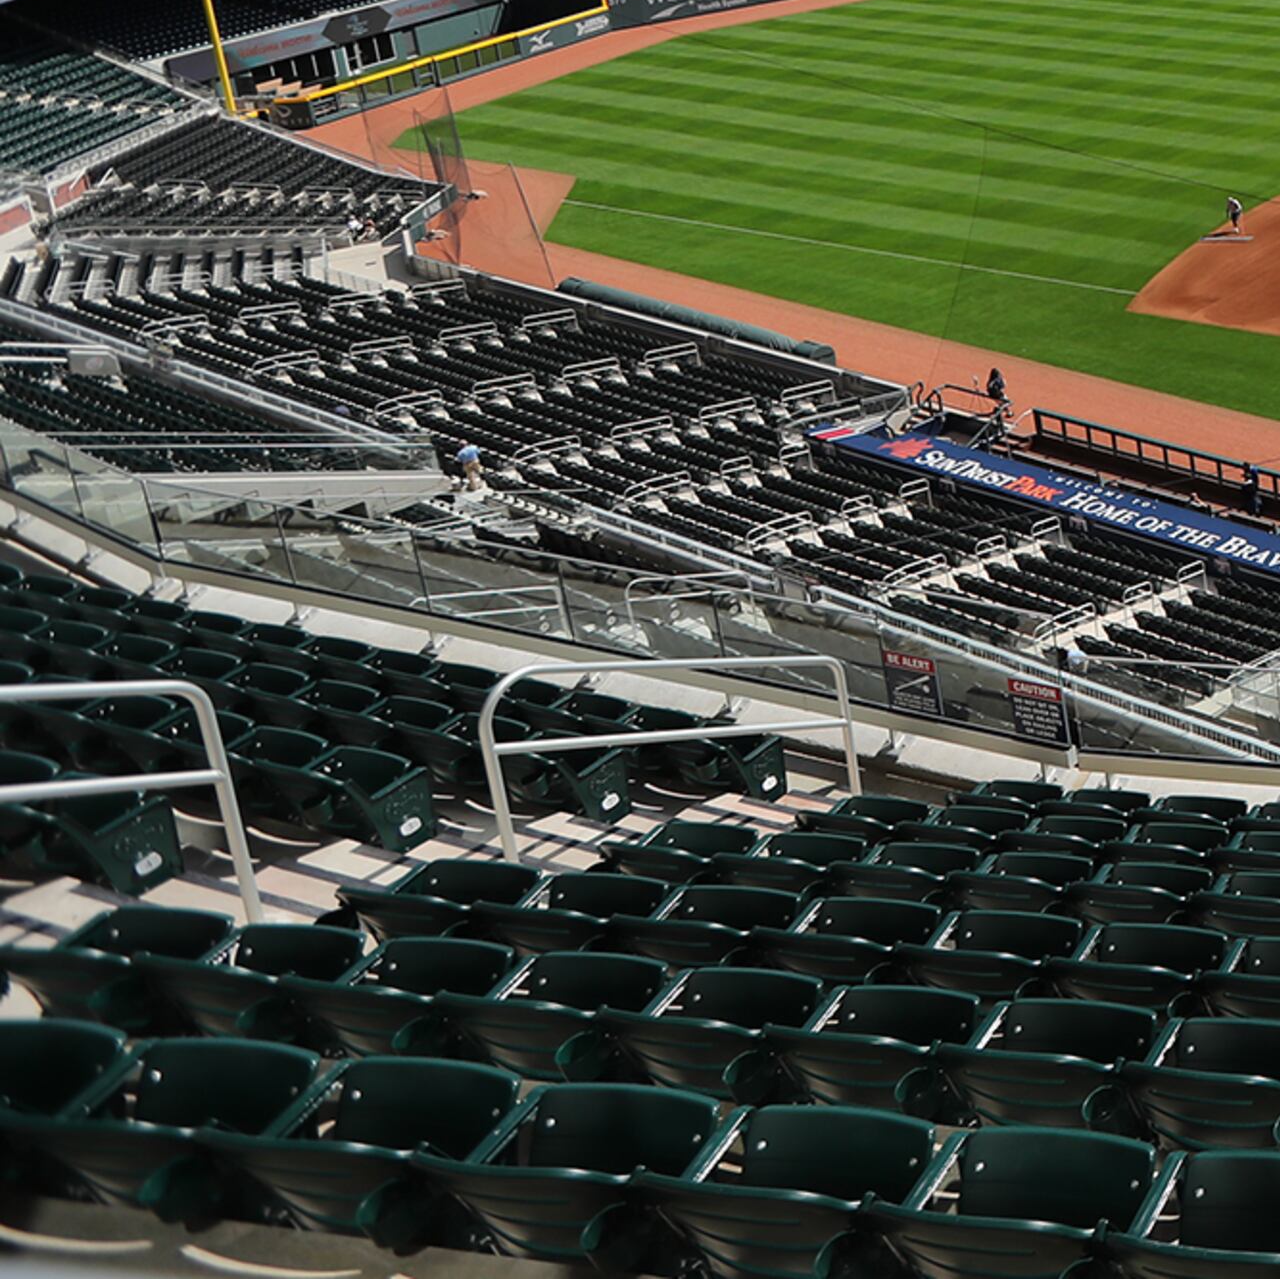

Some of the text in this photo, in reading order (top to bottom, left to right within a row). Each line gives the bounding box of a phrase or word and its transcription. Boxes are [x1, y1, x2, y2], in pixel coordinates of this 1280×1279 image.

[1059, 491, 1140, 524] HOME
[1134, 516, 1167, 533] OF
[1168, 524, 1220, 549] THE
[1013, 680, 1057, 699] CAUTION
